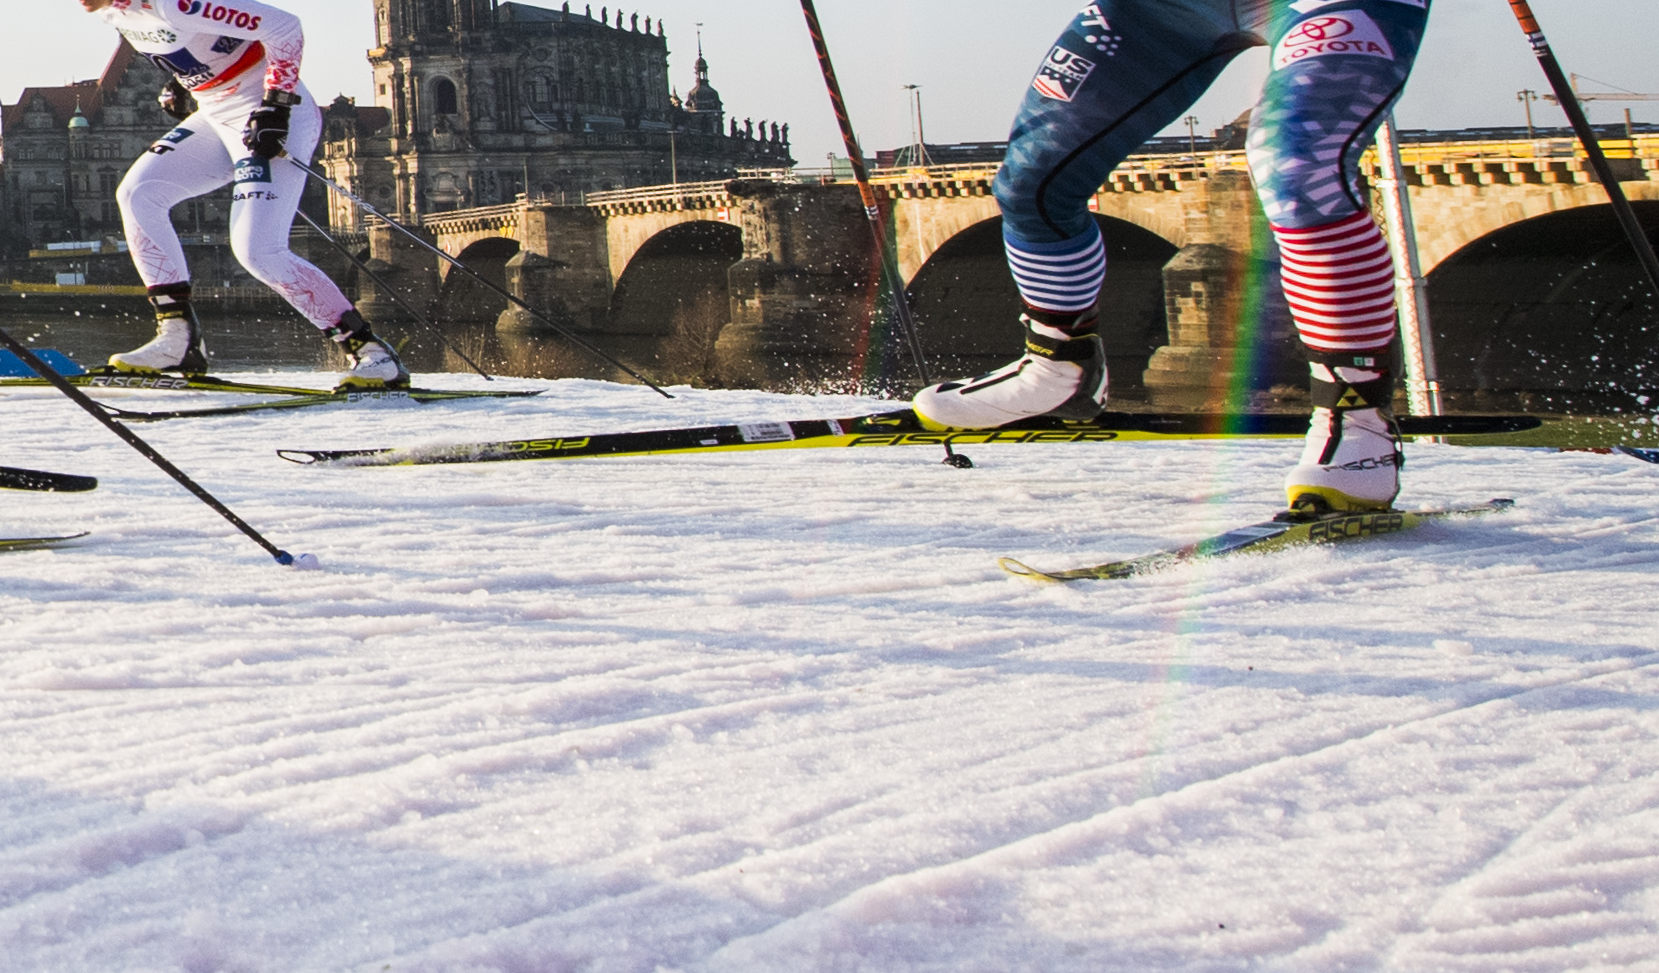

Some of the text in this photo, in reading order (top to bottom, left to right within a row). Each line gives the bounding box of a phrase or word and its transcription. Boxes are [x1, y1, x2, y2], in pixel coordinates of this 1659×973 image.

[201, 2, 262, 31] LOTOS
[1050, 48, 1093, 76] US
[1280, 40, 1387, 64] TOYOTA
[91, 377, 189, 390] FISCHER
[347, 390, 410, 403] FISCHER
[847, 430, 1119, 447] FISCHER
[1323, 454, 1396, 472] FISCHE
[1309, 514, 1404, 541] FISCHER
